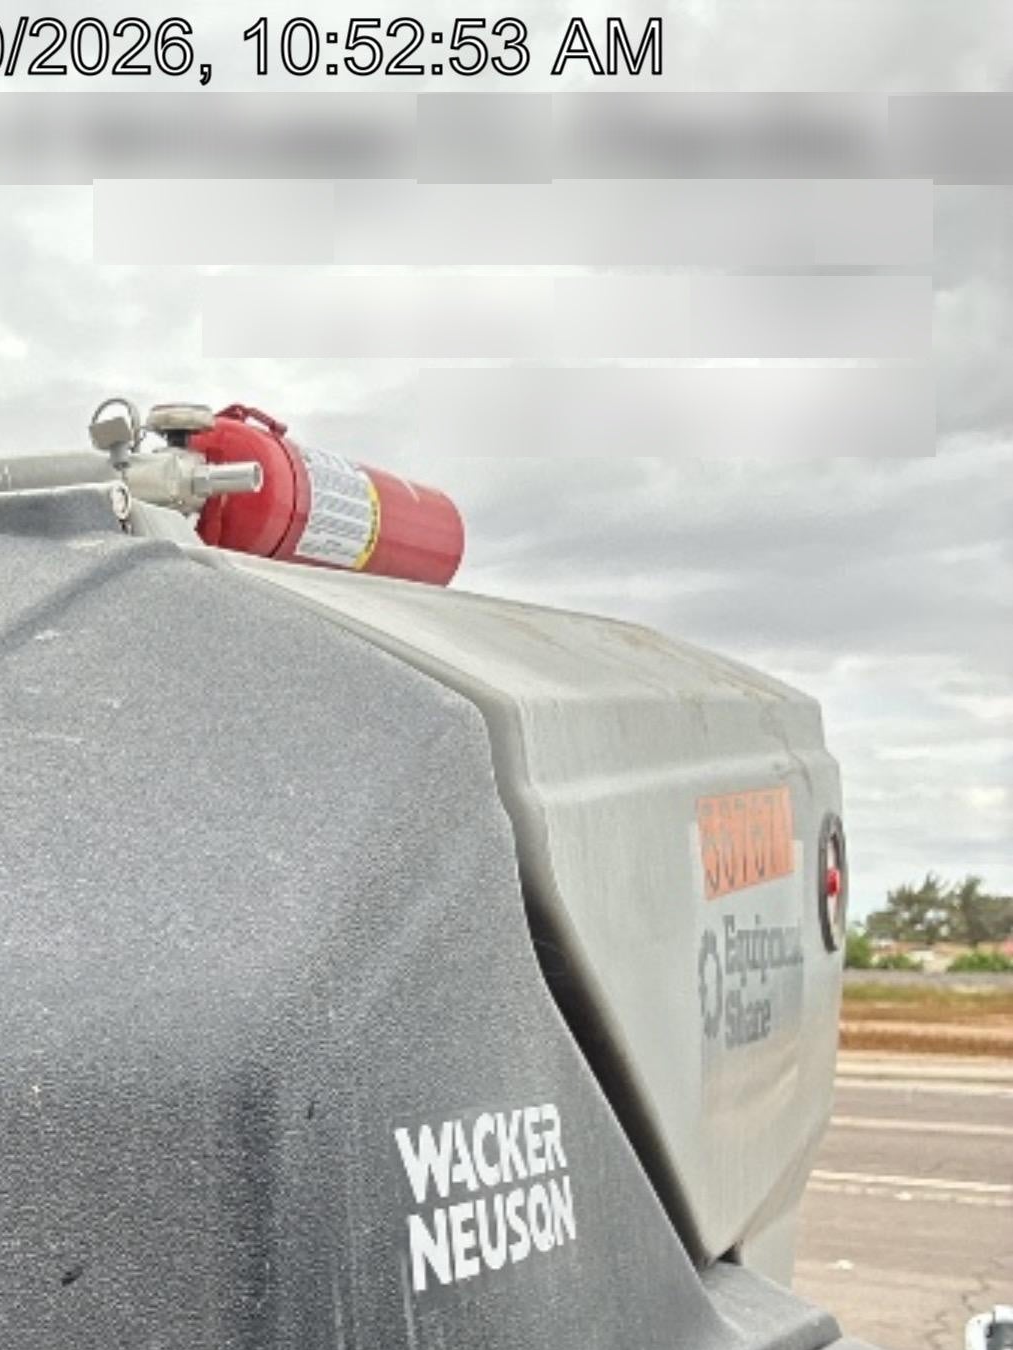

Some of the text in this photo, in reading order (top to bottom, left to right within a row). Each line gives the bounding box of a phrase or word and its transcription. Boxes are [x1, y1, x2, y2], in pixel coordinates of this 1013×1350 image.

[725, 989, 771, 1050] Share
[394, 1103, 567, 1204] WACKER
[407, 1175, 576, 1292] NEUSON
